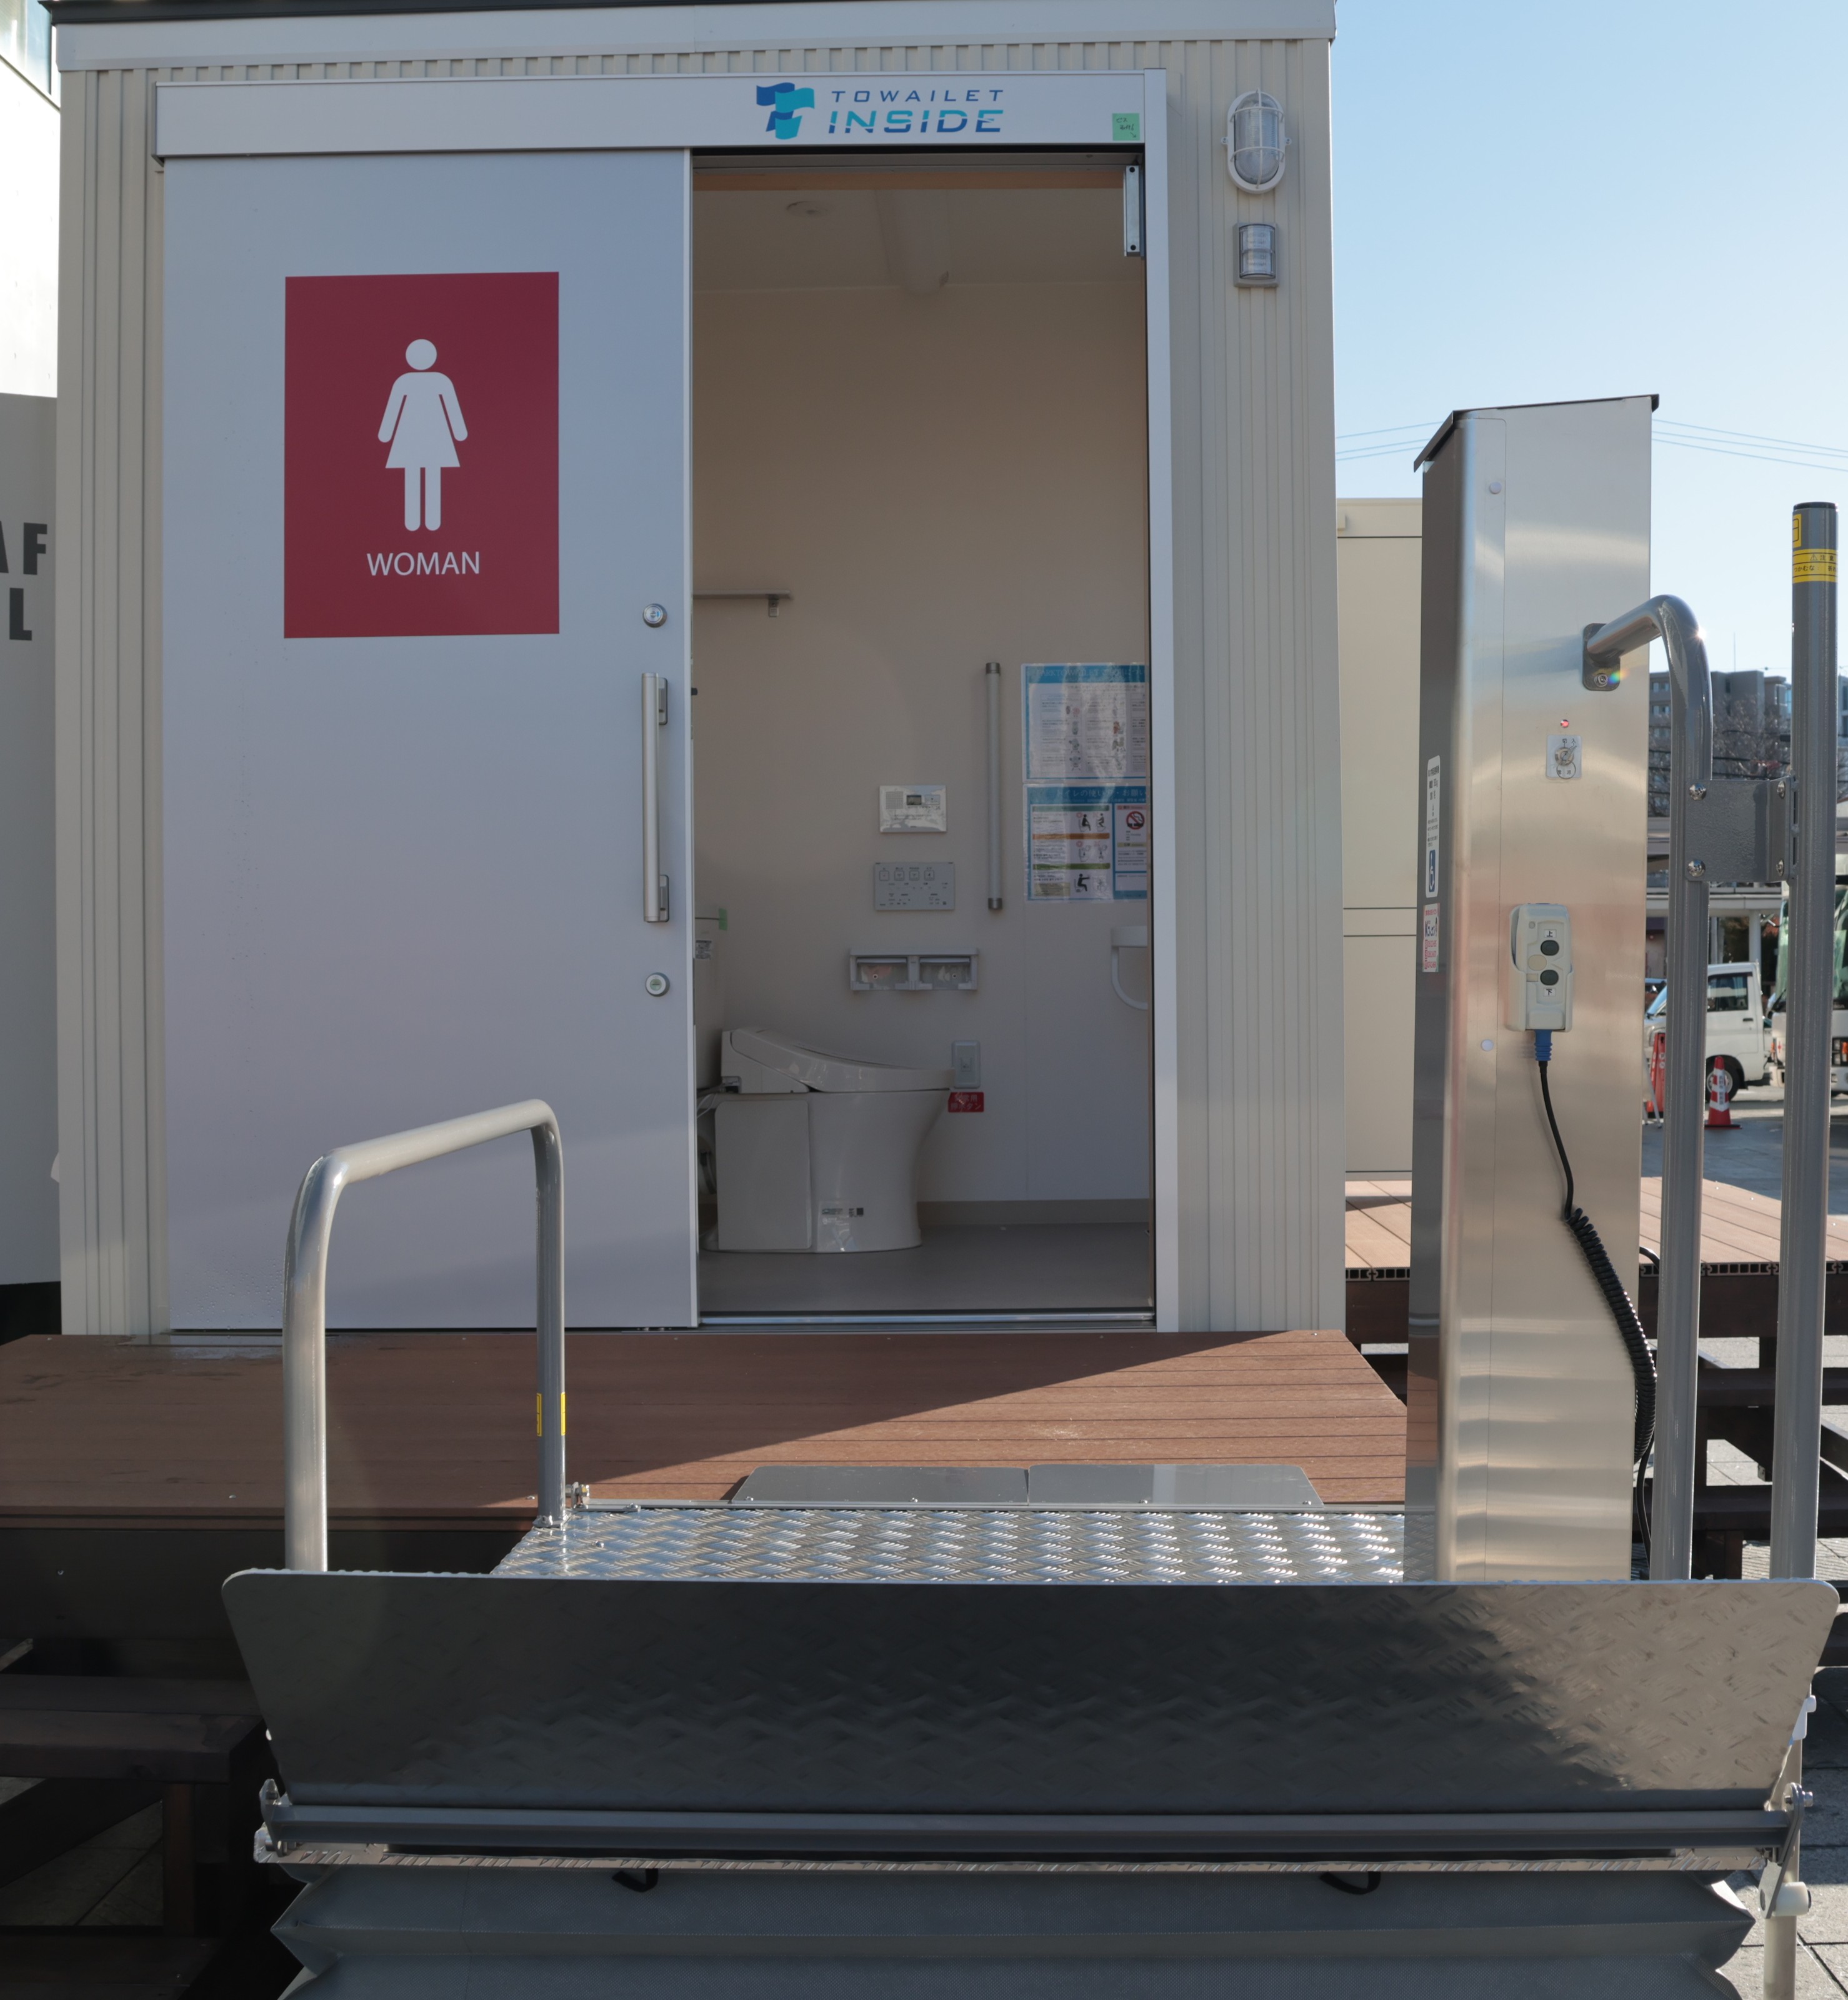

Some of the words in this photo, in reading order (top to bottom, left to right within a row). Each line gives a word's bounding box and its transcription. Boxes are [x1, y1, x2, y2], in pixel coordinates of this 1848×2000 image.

[831, 89, 1004, 102] TOWAILET
[828, 109, 1004, 134] INSIDE
[0, 521, 47, 576] F
[366, 551, 481, 576] WOMAN
[9, 587, 32, 641] L
